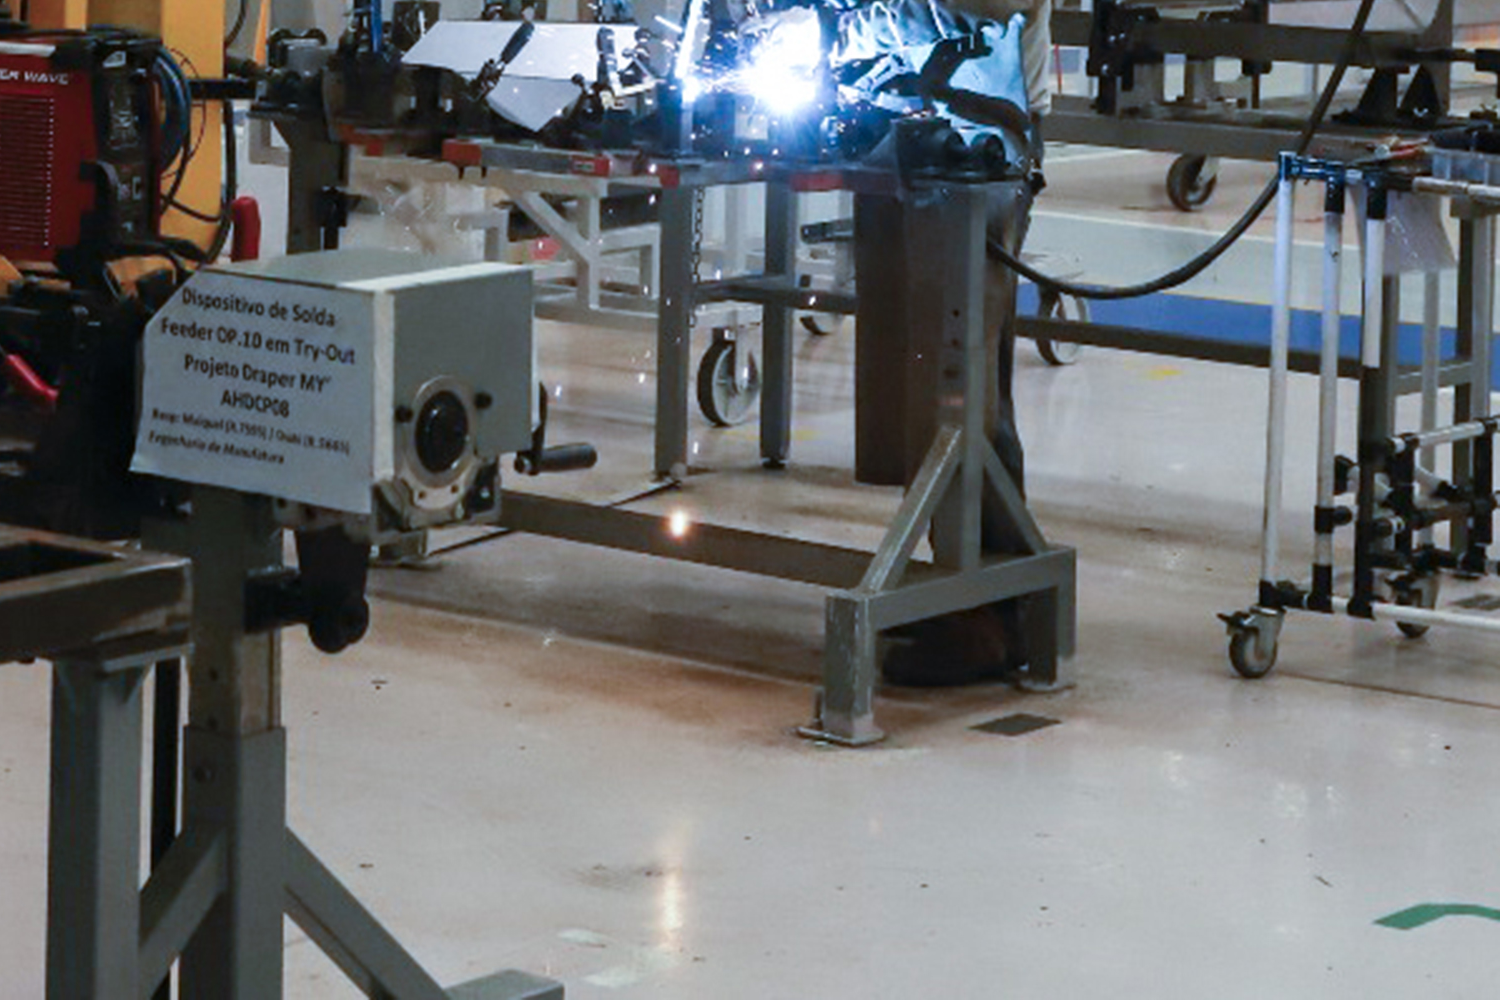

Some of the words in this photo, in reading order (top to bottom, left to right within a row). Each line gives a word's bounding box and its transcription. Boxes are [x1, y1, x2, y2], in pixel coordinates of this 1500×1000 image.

[24, 71, 69, 86] WAVE
[182, 287, 265, 317] Dispositivo
[269, 301, 288, 319] de
[293, 304, 336, 327] Solda
[160, 317, 213, 341] Feeder
[265, 339, 290, 354] em
[294, 339, 356, 365] Try-Out
[184, 353, 240, 379] Projeto
[242, 363, 297, 389] Draper
